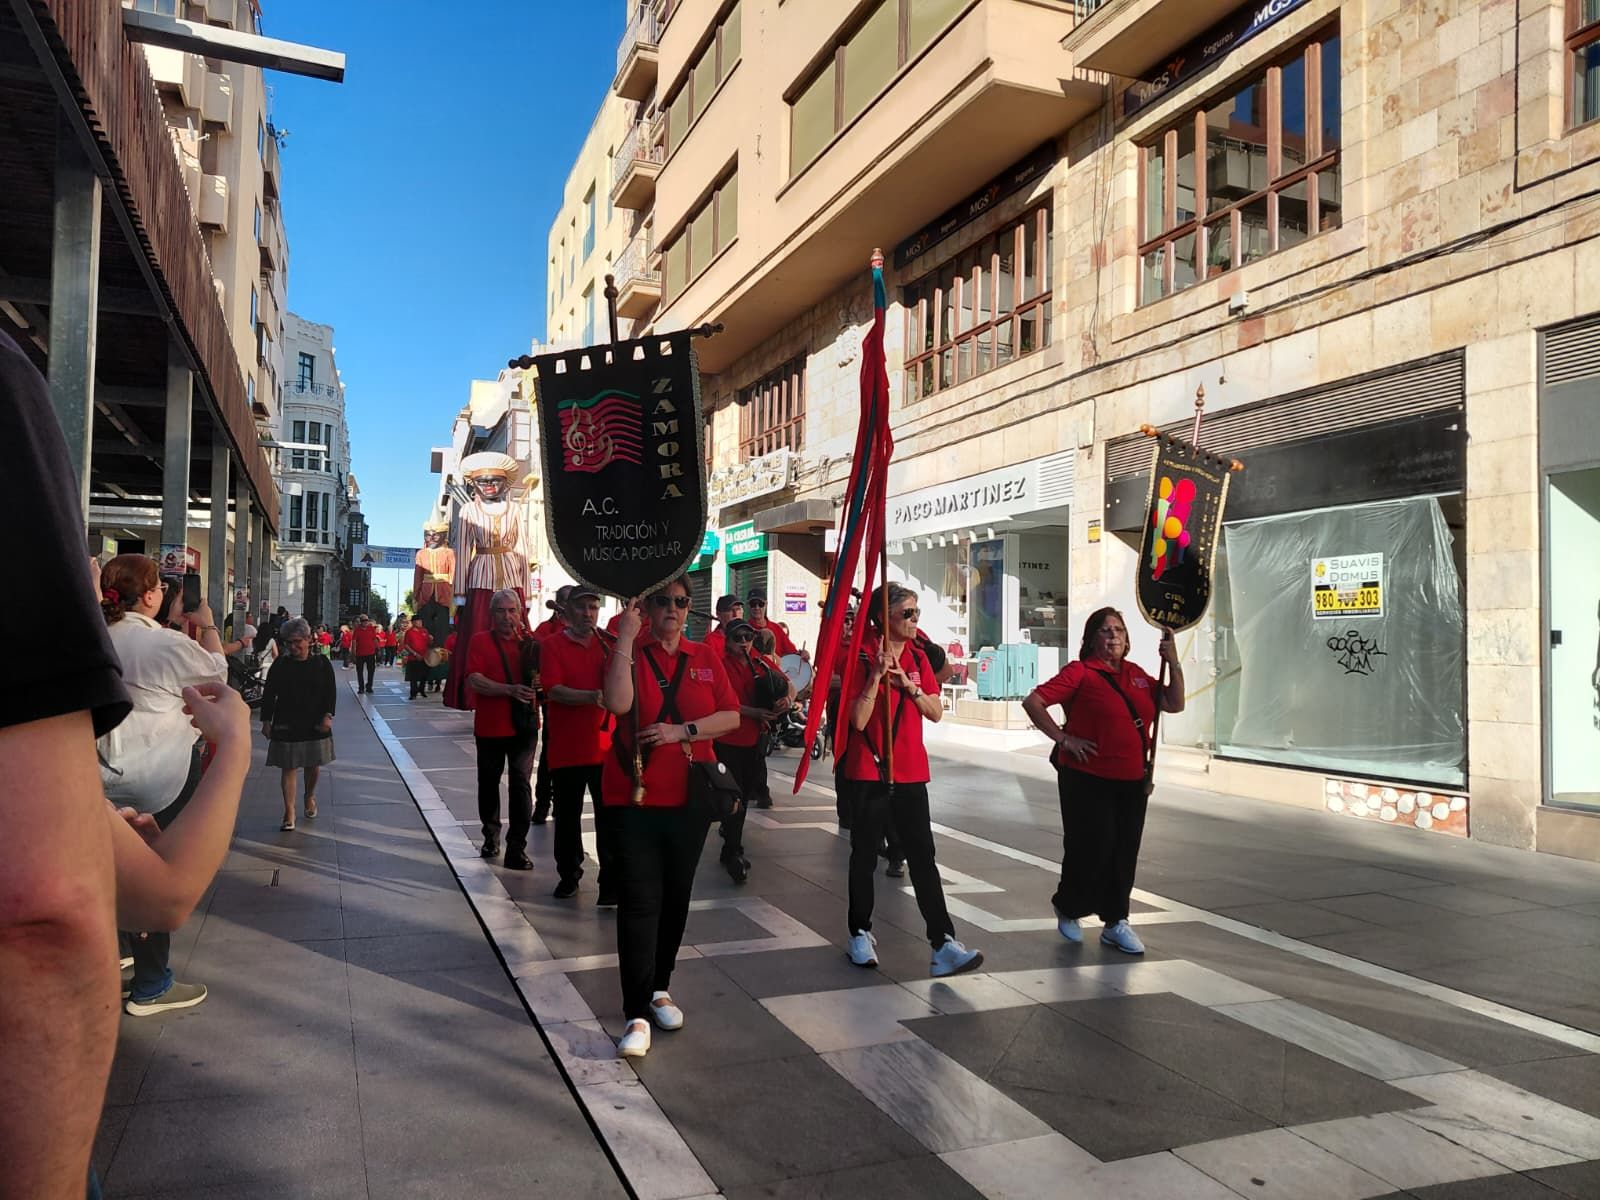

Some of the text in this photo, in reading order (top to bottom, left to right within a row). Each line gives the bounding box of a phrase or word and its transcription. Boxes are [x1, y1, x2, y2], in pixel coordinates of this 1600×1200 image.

[1138, 0, 1293, 102] MGS Seguros MGS
[969, 194, 990, 216] MGS
[651, 377, 685, 499] ZAMORA
[582, 497, 620, 516] A.C.
[595, 520, 670, 541] TRADICIÓN Y
[631, 540, 682, 560] POPULAR
[1315, 593, 1334, 609] 980
[1360, 590, 1379, 606] 303
